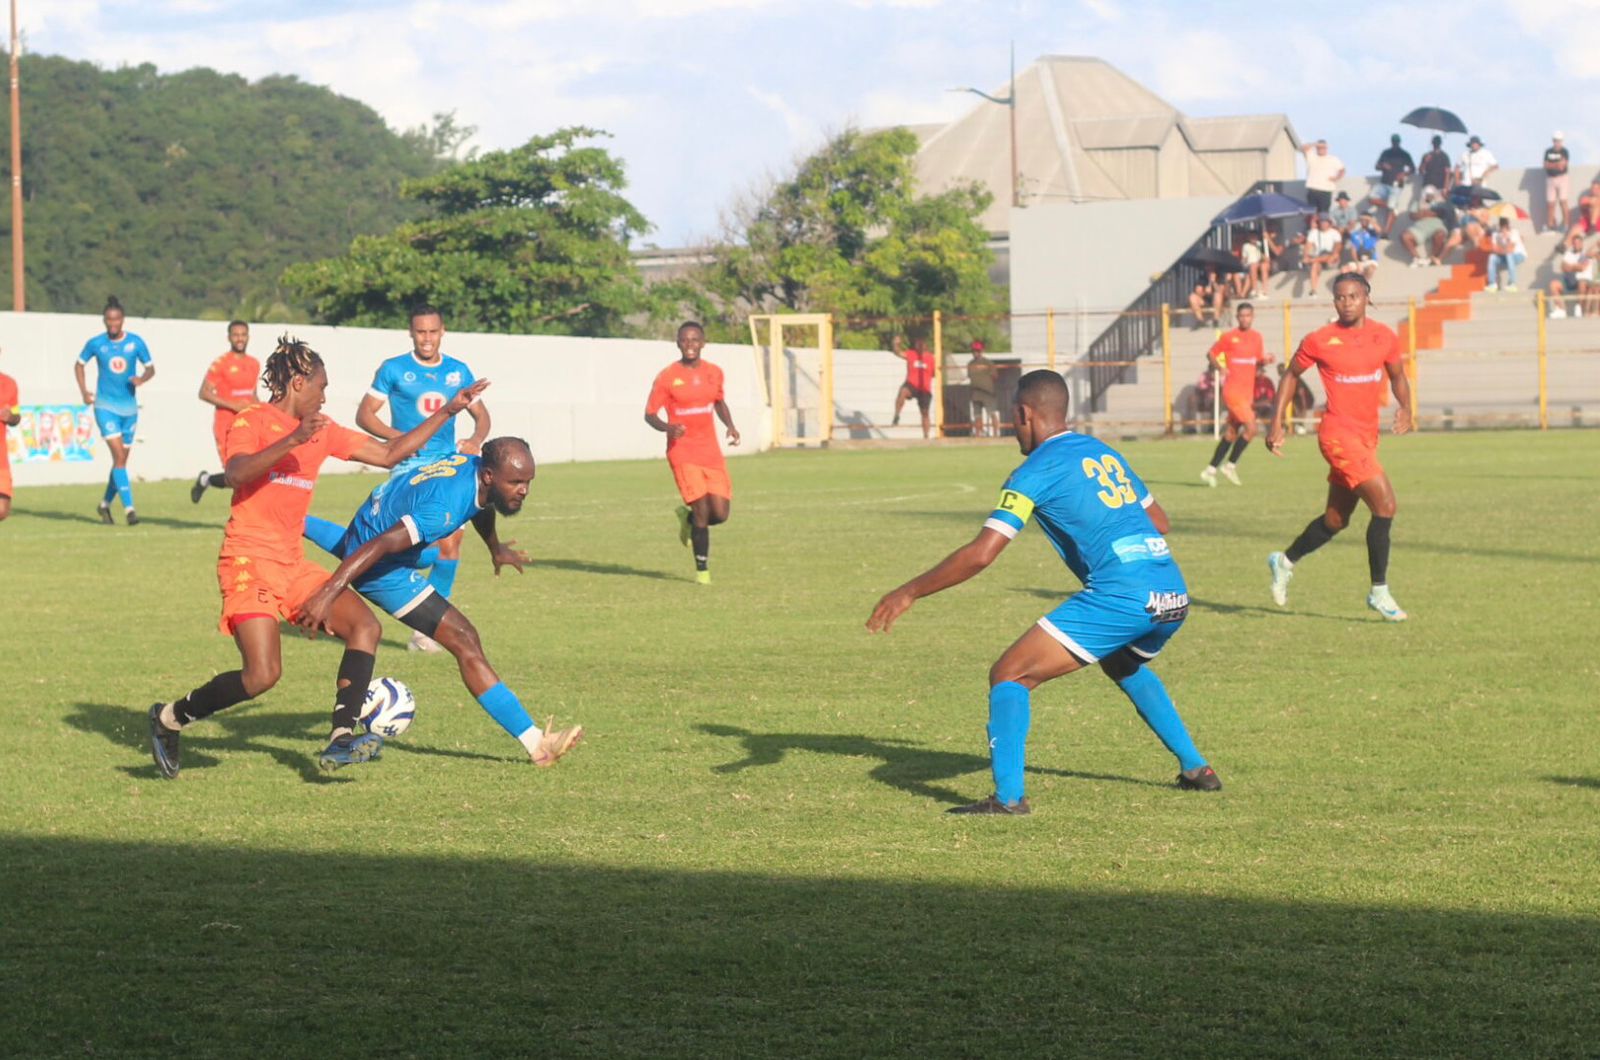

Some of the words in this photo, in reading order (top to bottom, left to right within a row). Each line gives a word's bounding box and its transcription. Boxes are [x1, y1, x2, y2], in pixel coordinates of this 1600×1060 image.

[424, 398, 442, 413] U
[1082, 454, 1137, 509] 33
[1001, 491, 1018, 510] C
